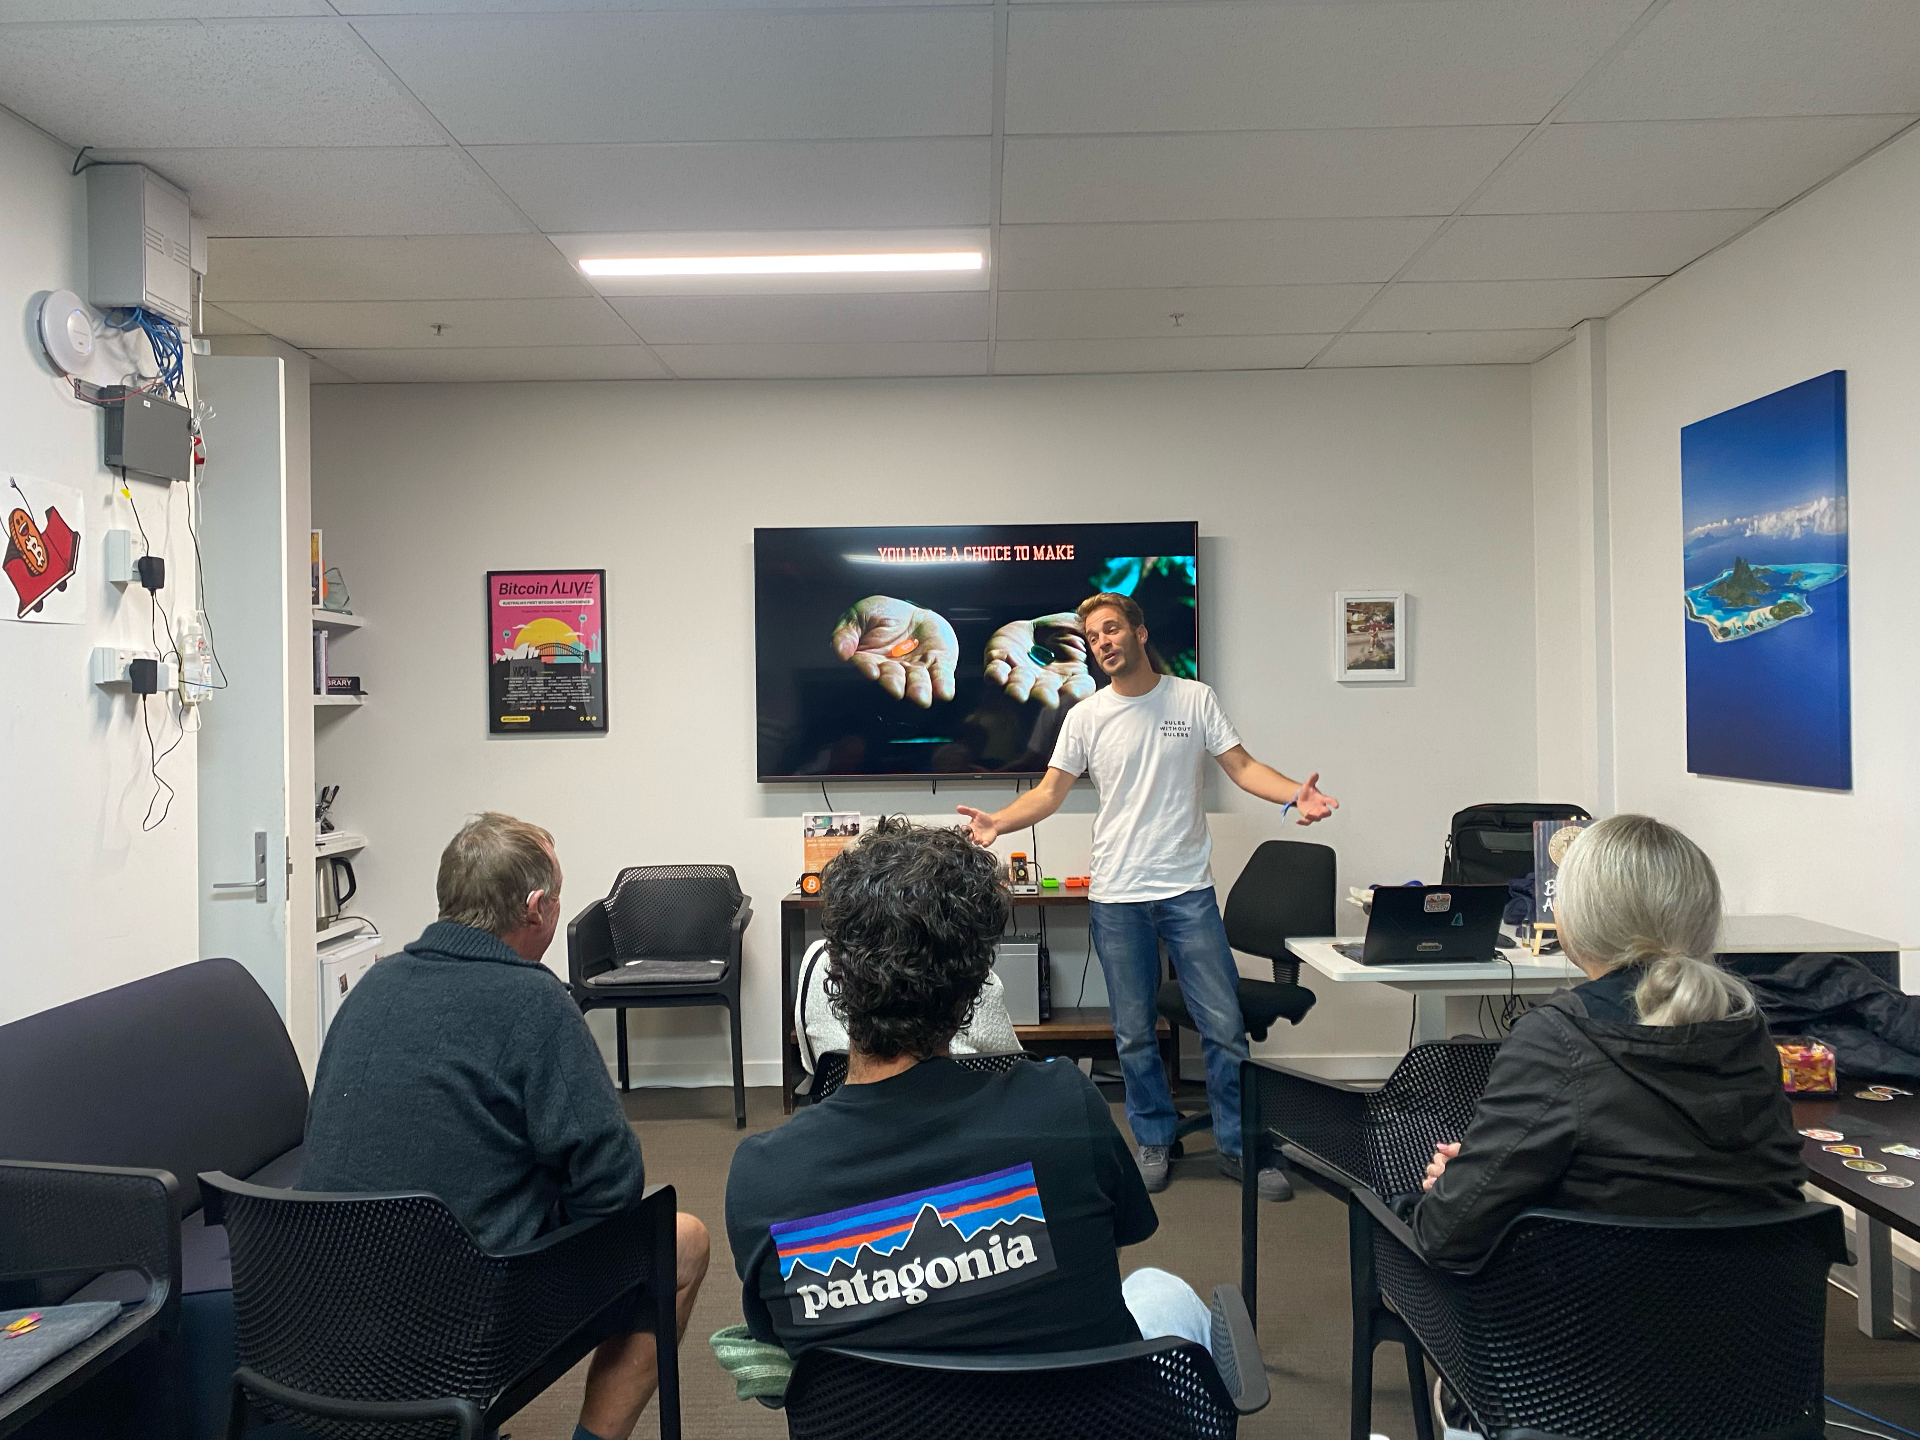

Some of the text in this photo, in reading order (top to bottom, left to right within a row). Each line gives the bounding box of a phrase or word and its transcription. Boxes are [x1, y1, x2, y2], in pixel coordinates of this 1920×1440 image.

[877, 545, 1075, 563] YOU HAVE A CHOICE TO MAKE
[499, 582, 548, 595] Bitcoin
[797, 1233, 1038, 1319] patagonia
